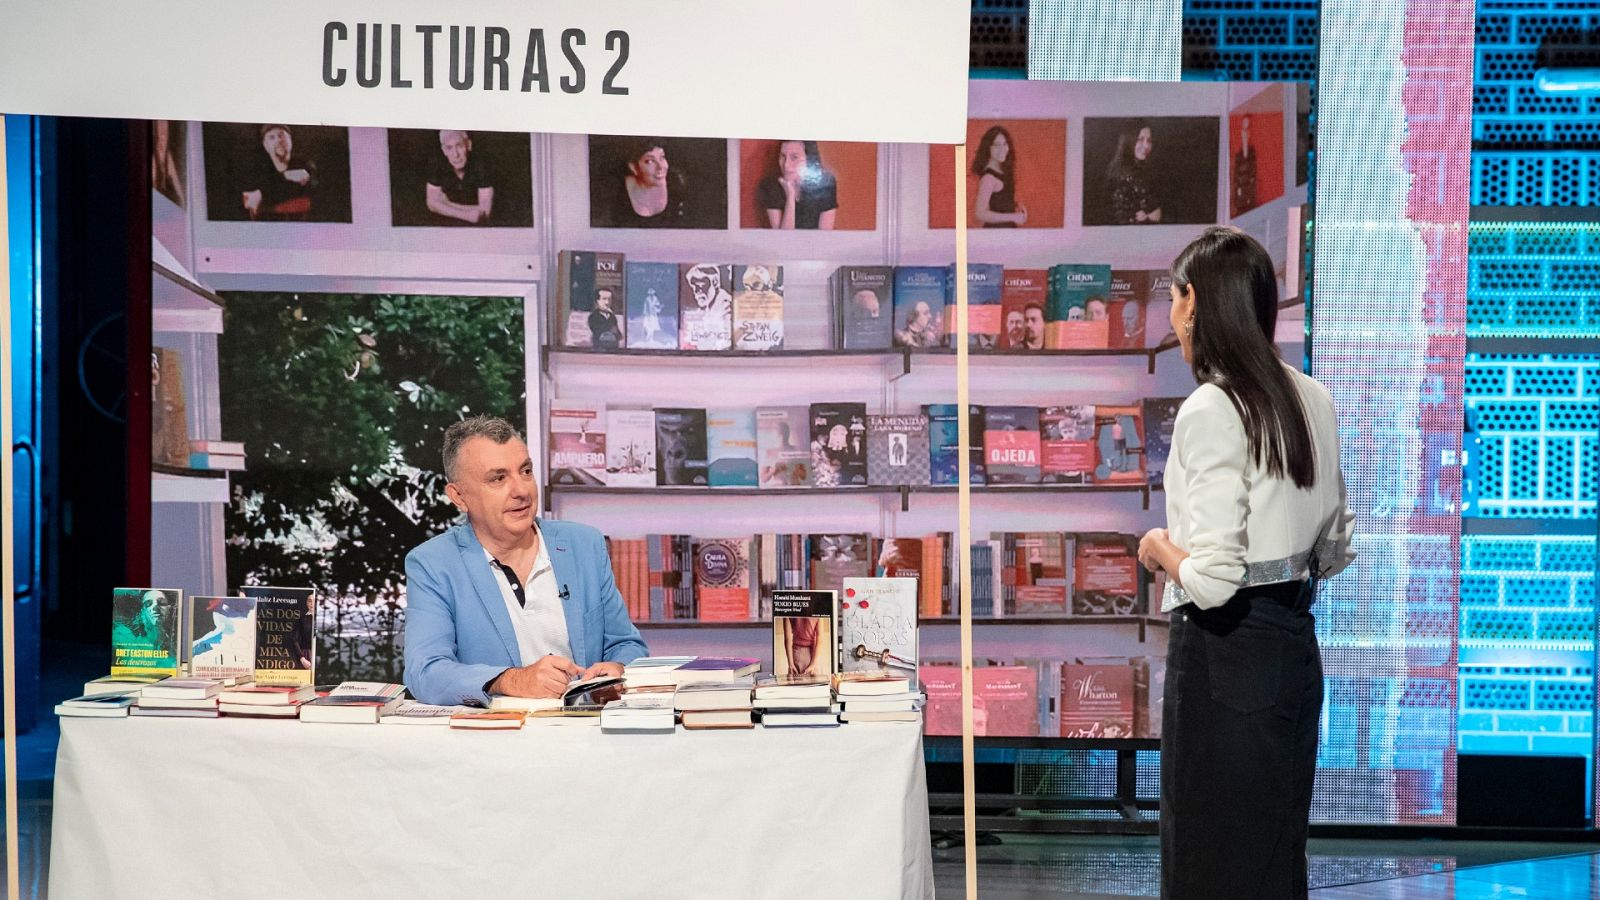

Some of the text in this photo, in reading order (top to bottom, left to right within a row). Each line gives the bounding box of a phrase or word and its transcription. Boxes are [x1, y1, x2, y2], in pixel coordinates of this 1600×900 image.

[322, 21, 630, 96] CULTURAS 2
[991, 448, 1036, 463] OJEDA
[257, 608, 301, 620] AS DOS
[257, 620, 294, 633] VIDAS
[266, 633, 284, 645] DE
[153, 650, 169, 659] ELLIS
[260, 646, 290, 658] MINA
[256, 659, 296, 670] NDIGO
